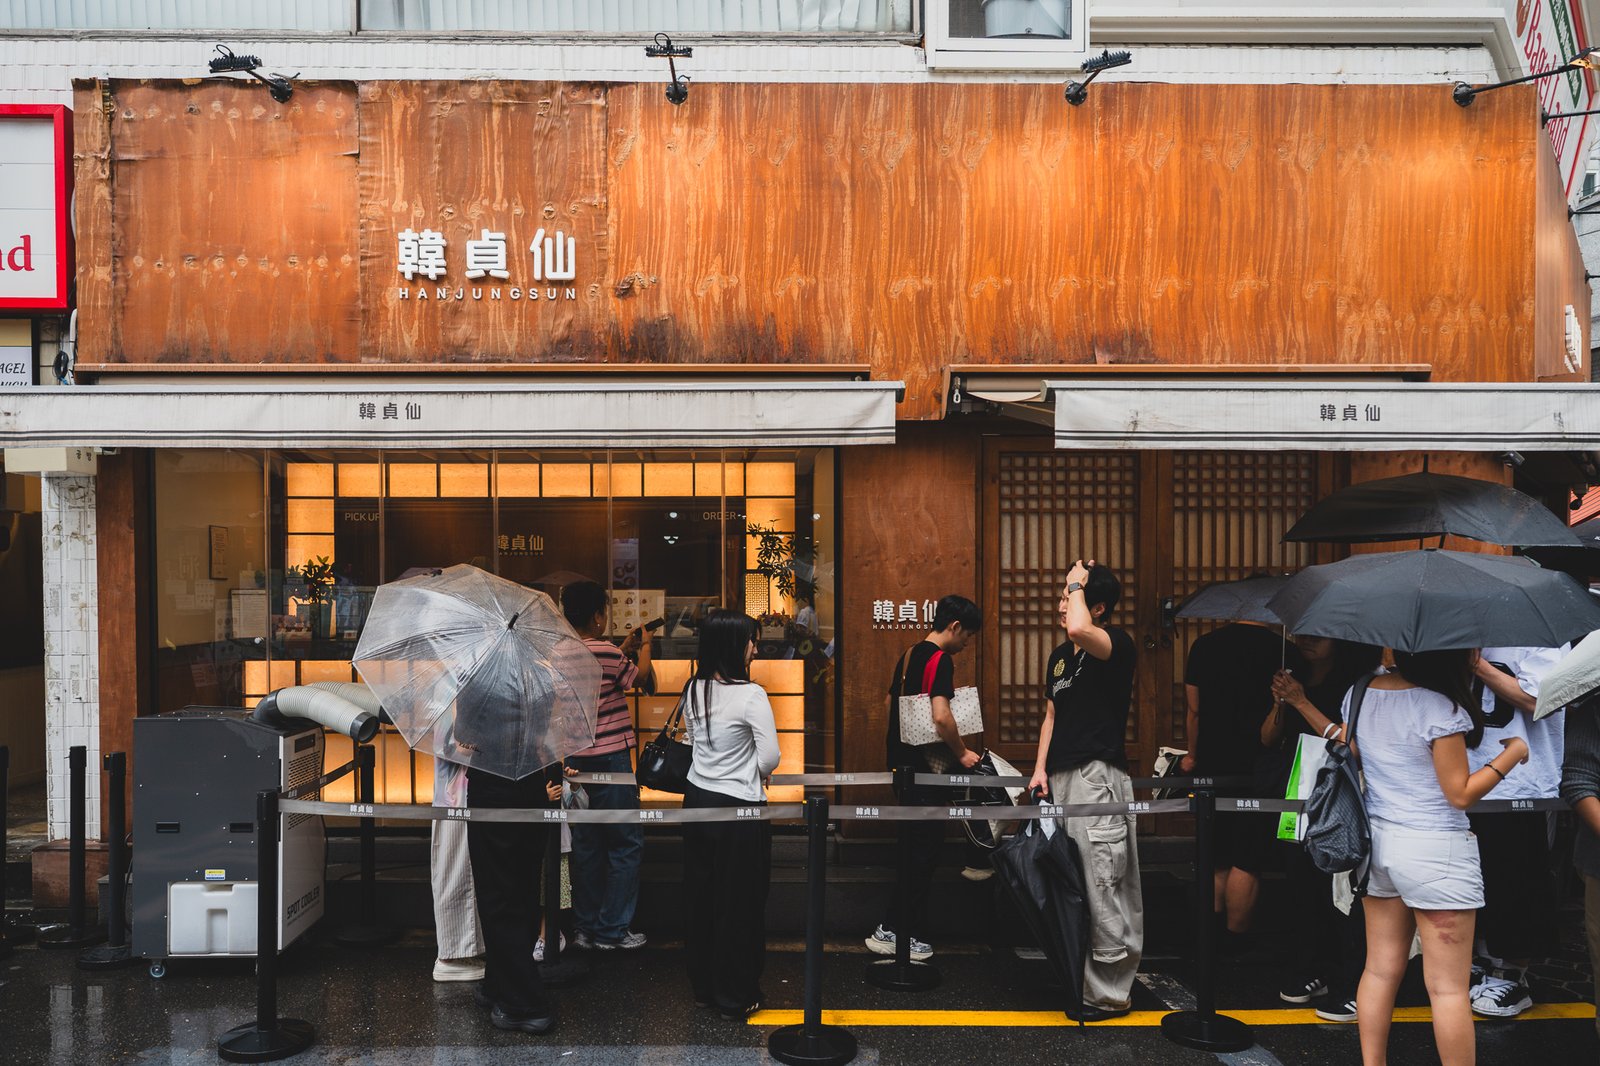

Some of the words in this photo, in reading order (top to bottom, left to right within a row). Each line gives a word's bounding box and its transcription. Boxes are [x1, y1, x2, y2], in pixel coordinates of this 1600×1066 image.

[397, 228, 576, 281] 韓貞仙
[399, 287, 577, 300] HANJUNGSUN
[359, 402, 422, 420] 韓貞仙
[1320, 403, 1381, 421] 韓貞仙
[344, 512, 367, 521] PICK
